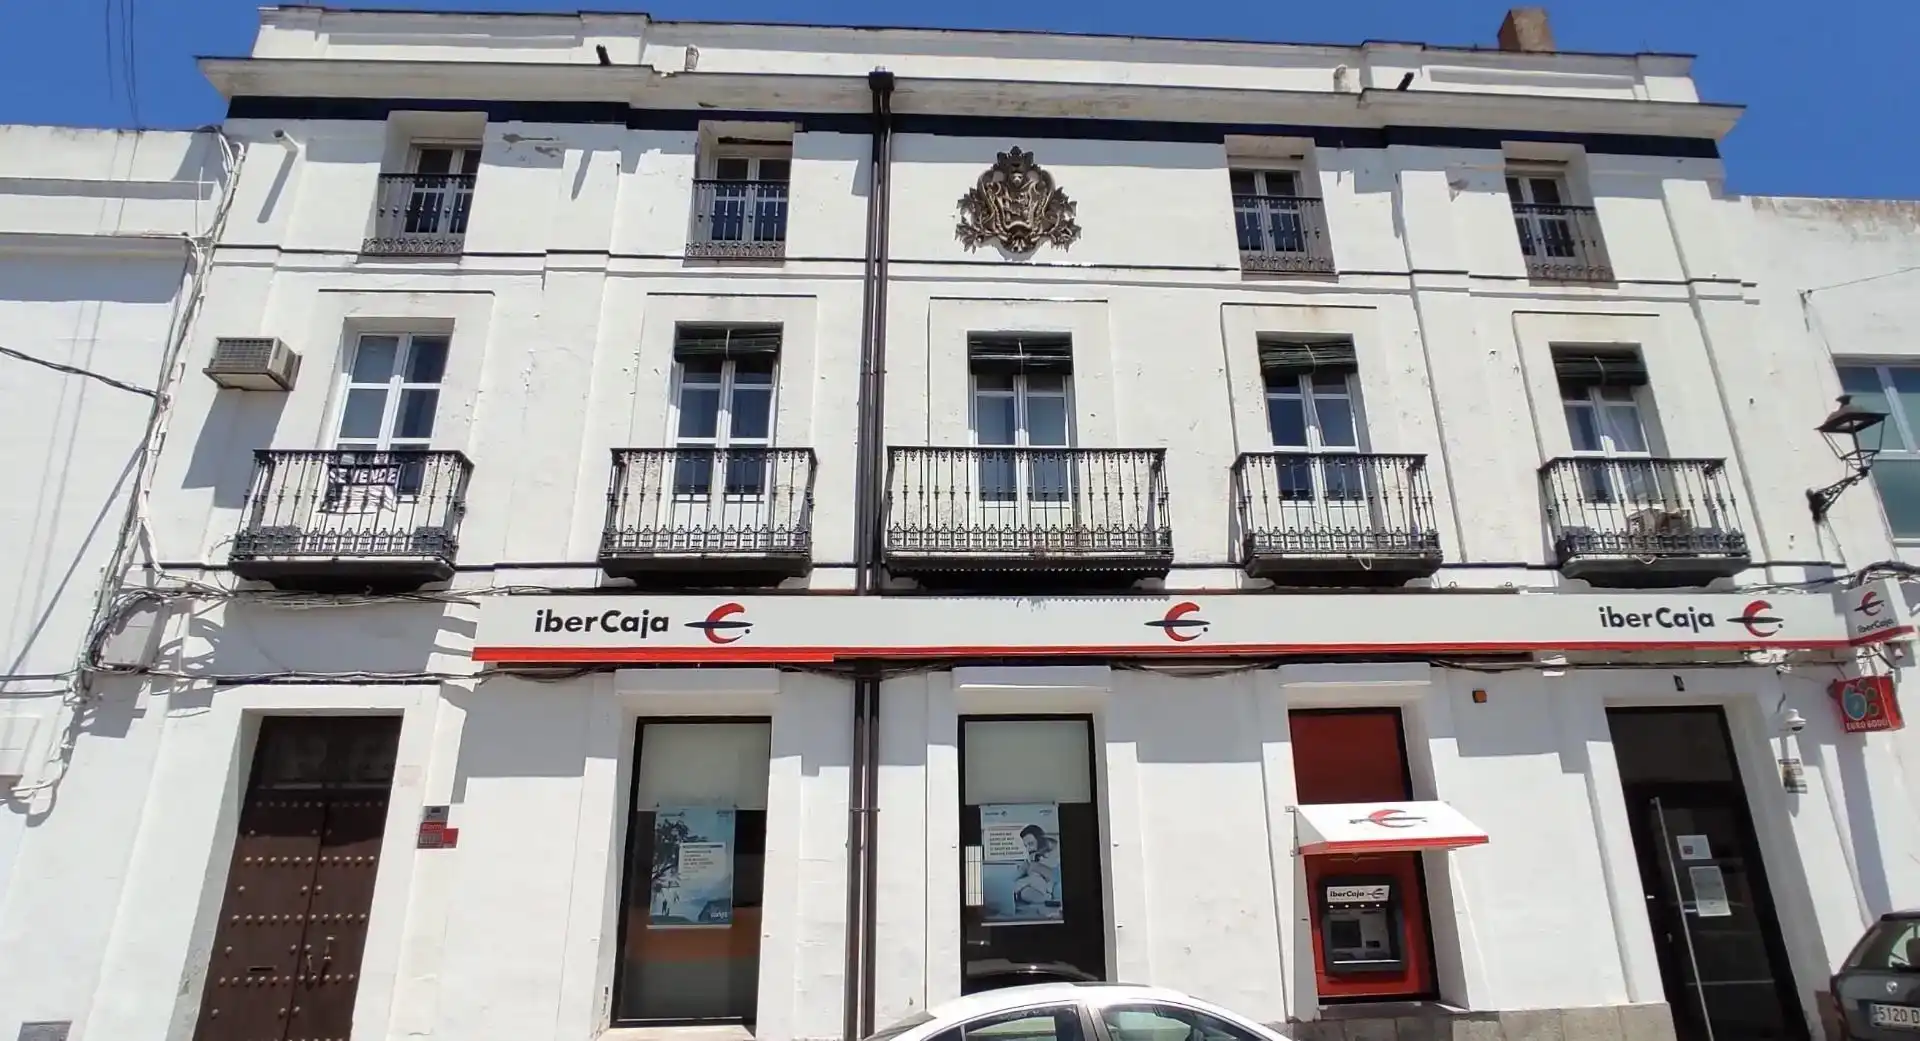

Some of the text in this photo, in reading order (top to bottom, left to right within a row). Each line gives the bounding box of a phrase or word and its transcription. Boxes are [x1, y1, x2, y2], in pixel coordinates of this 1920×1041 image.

[350, 466, 398, 485] VENDE
[534, 608, 670, 639] iberCaja
[1598, 605, 1715, 634] iberCaja
[1879, 1006, 1908, 1023] 5120
